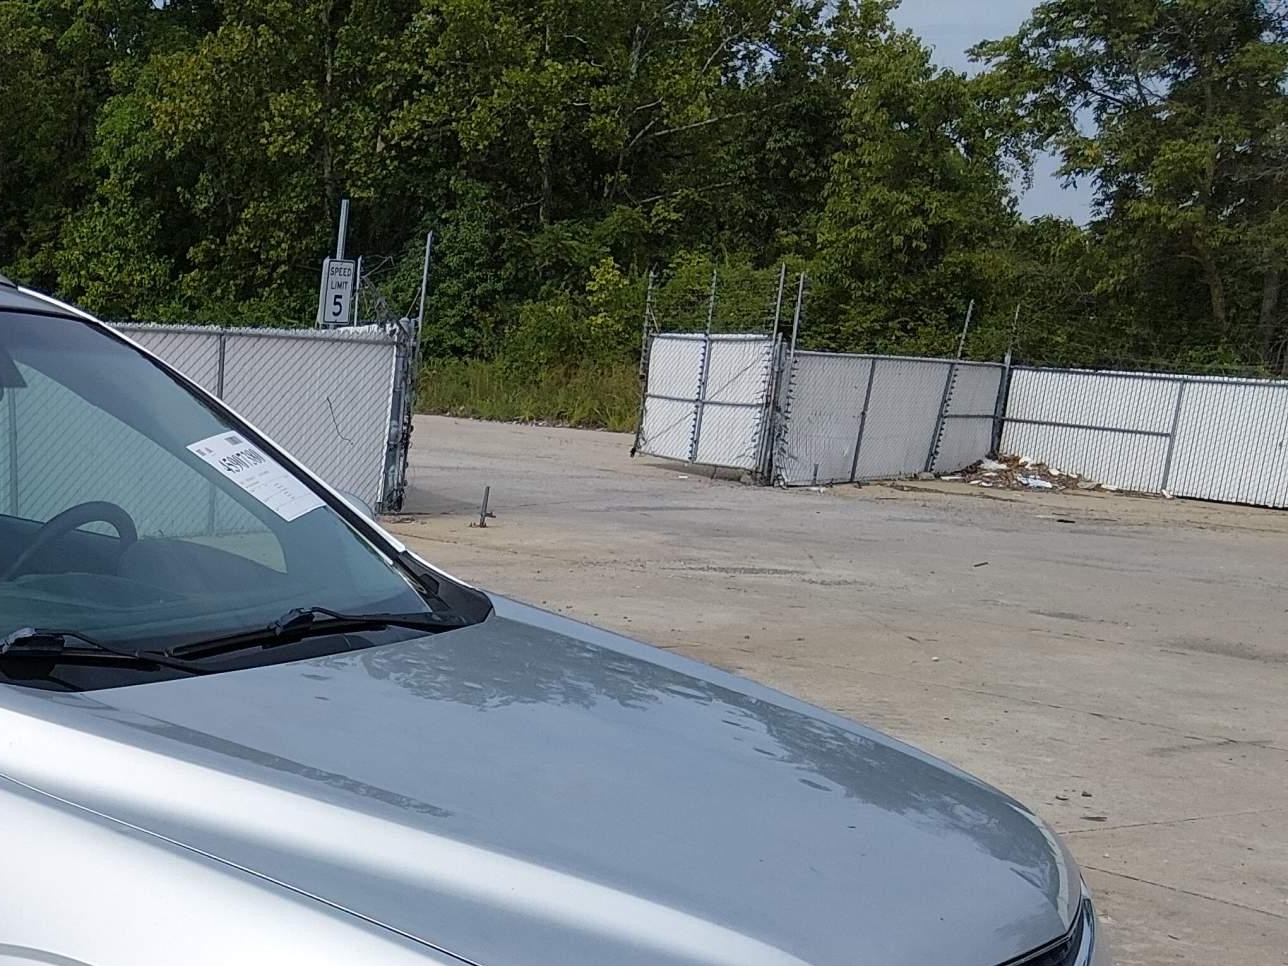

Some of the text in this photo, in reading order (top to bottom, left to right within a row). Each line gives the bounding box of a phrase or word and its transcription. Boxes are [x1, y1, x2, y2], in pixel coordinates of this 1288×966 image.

[330, 266, 352, 277] SPEED
[330, 281, 349, 290] LIMIT
[332, 294, 343, 317] 5
